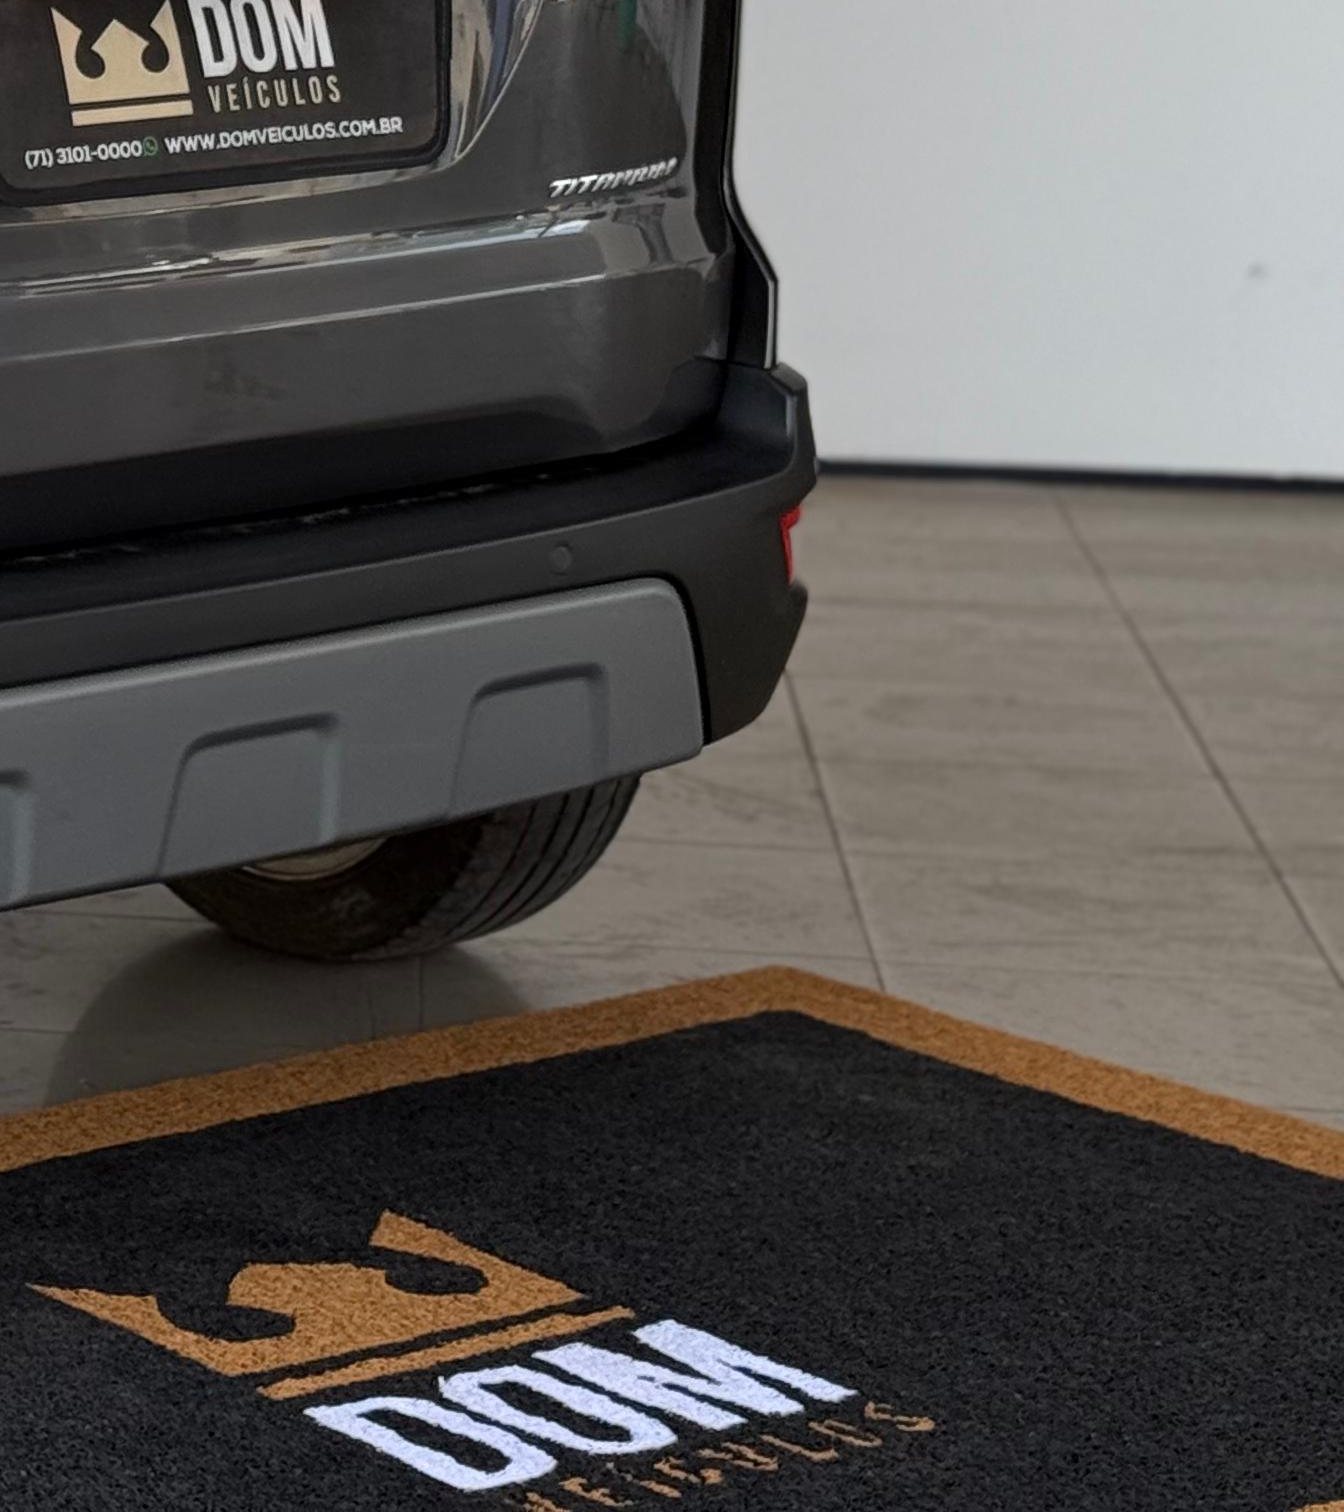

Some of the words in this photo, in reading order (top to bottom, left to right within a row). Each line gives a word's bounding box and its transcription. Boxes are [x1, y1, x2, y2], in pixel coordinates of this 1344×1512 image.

[208, 75, 341, 113] VEÍCULOS
[24, 148, 54, 170] (71)
[56, 142, 143, 164] 3101-0000
[164, 115, 404, 154] WWW.DOMVEICULOS.COM.BR
[549, 156, 678, 199] TITANIUM
[303, 1319, 859, 1492] DOM
